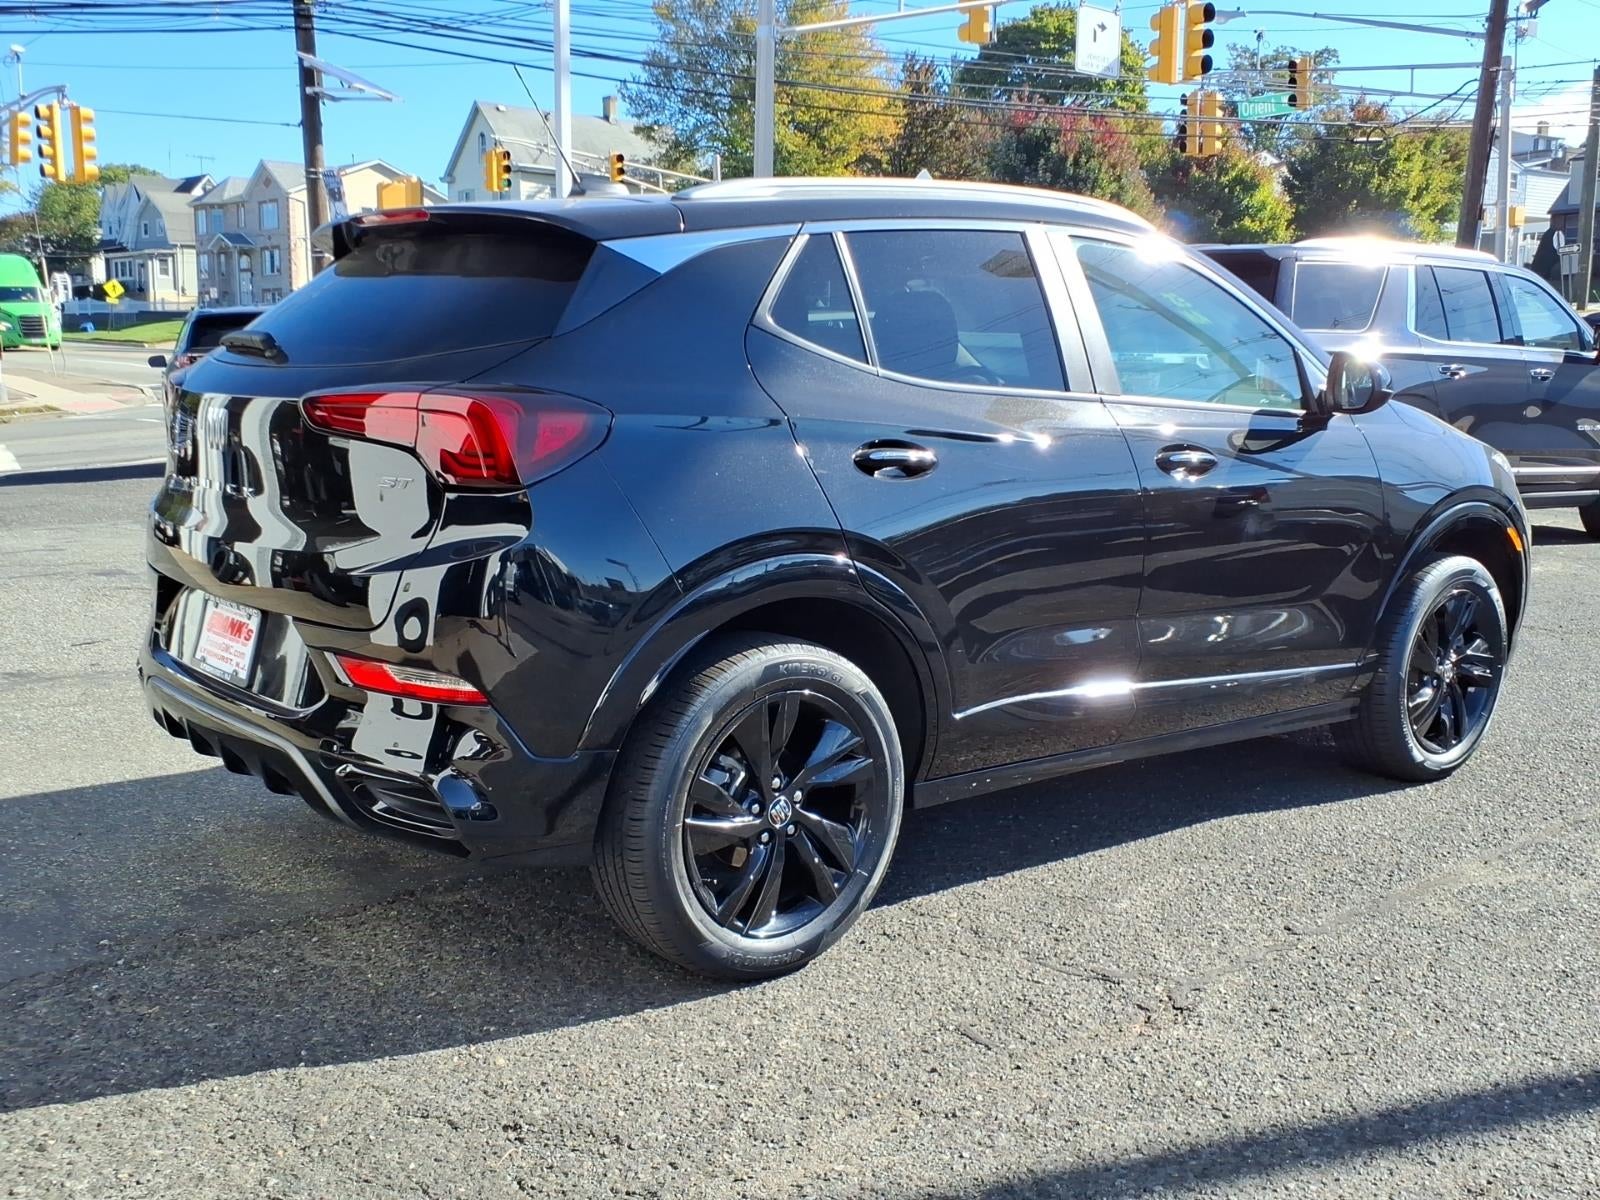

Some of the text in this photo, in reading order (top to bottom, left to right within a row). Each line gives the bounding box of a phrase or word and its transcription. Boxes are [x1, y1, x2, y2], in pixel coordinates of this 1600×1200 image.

[1241, 98, 1276, 117] Orient
[377, 476, 415, 489] ST
[207, 610, 254, 642] NK'S
